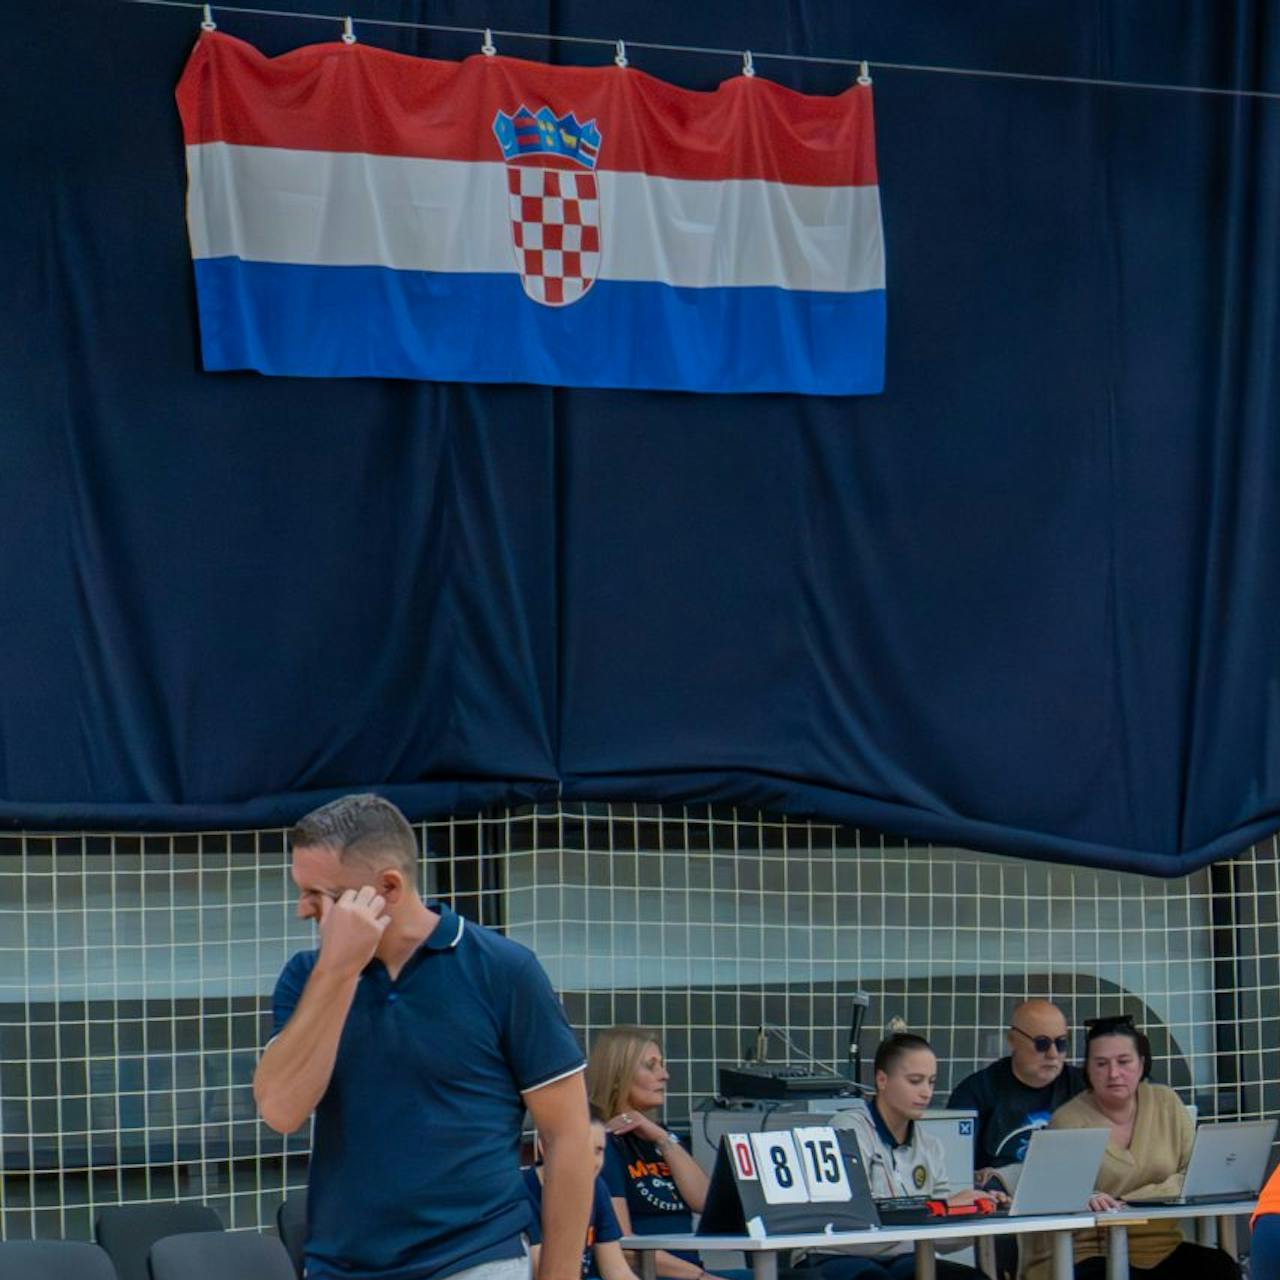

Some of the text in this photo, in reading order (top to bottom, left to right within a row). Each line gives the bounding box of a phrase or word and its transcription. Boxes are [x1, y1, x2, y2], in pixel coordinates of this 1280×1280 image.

[735, 1140, 842, 1189] 0 8 15
